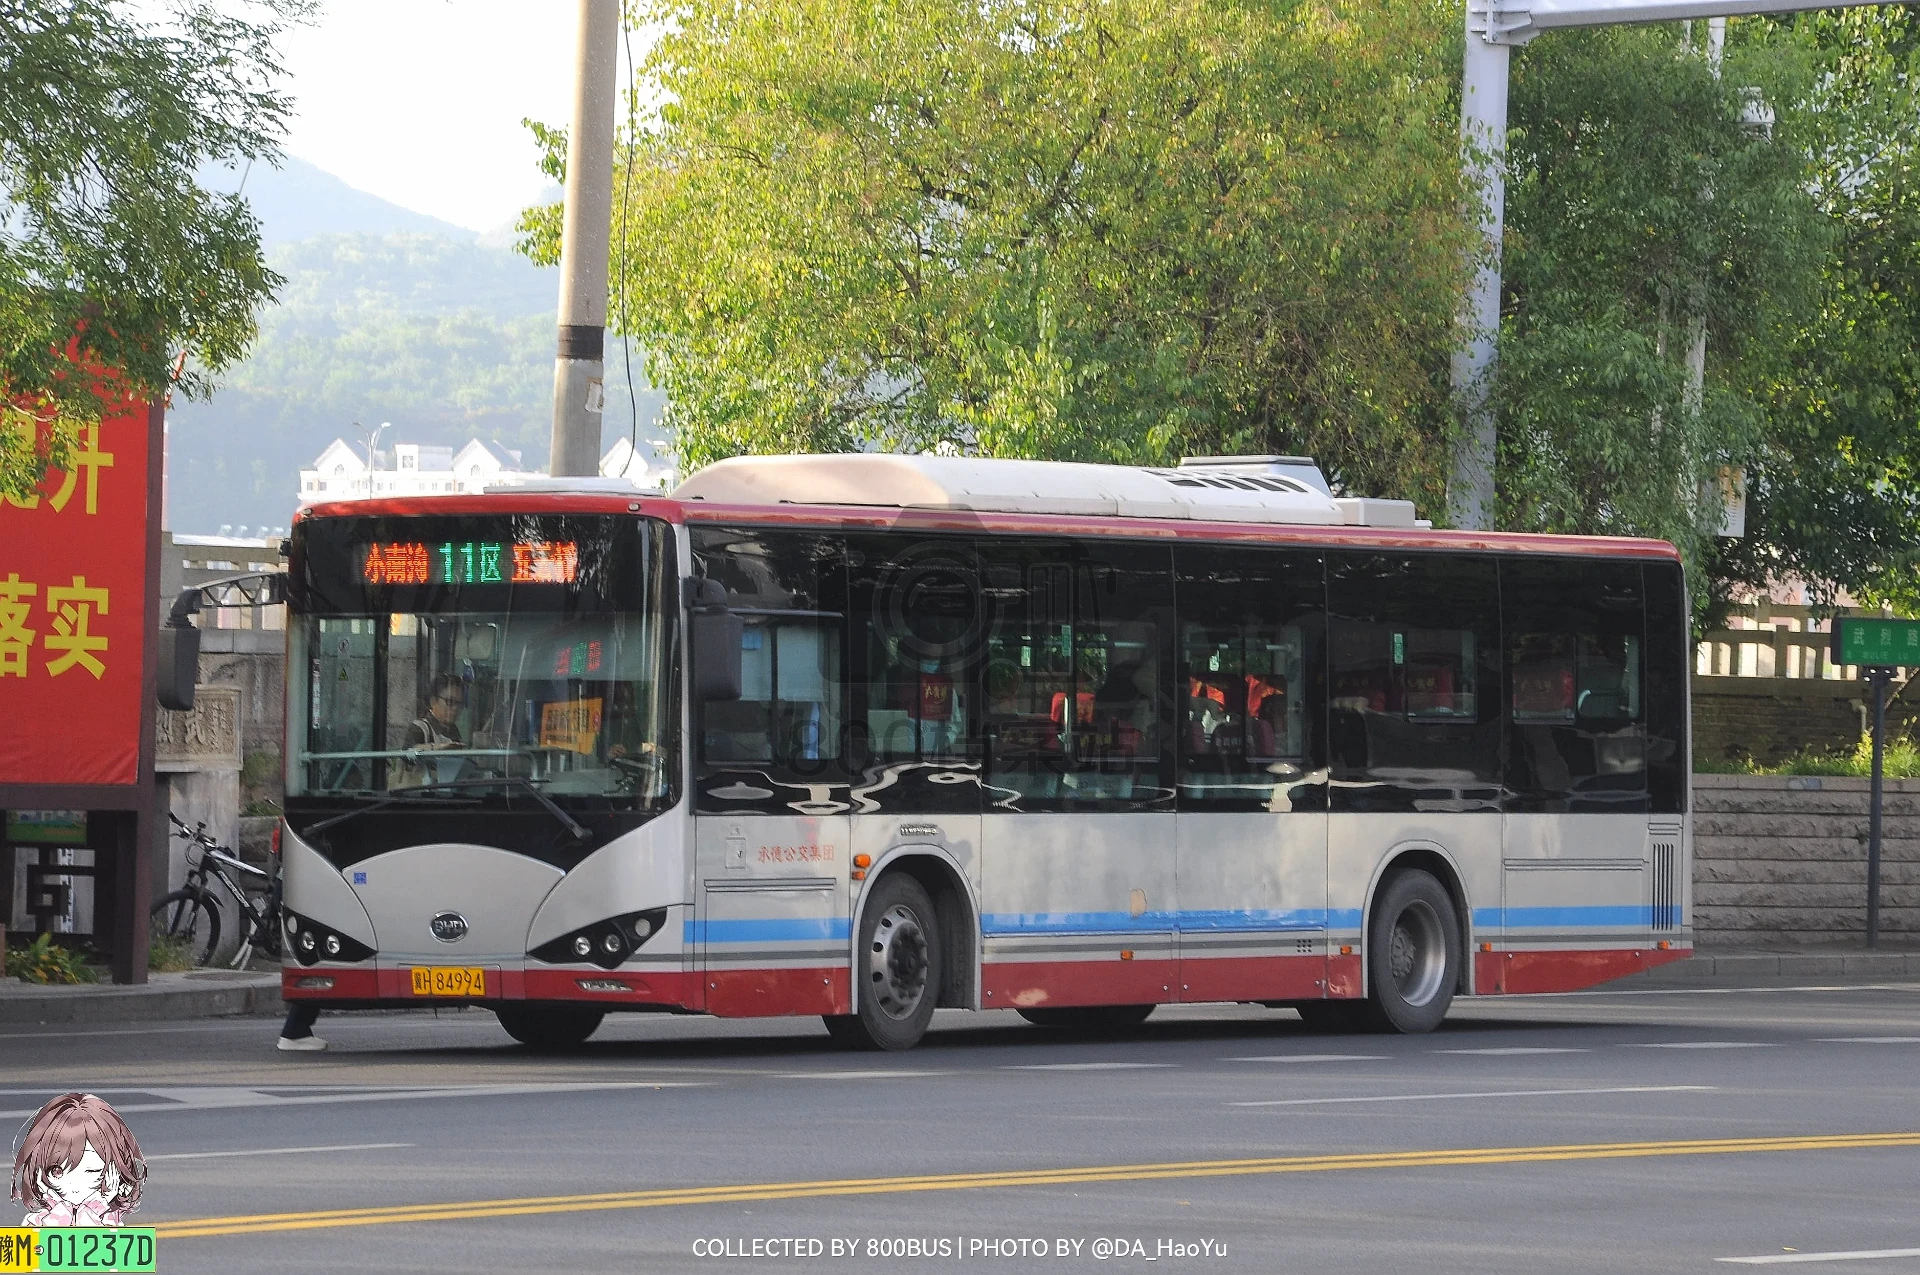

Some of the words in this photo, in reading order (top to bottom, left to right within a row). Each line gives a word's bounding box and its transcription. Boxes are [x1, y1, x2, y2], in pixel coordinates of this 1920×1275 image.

[0, 412, 114, 515] 升
[438, 542, 502, 583] 11区
[758, 843, 835, 864] 承德公交集团
[434, 919, 464, 933] BYD
